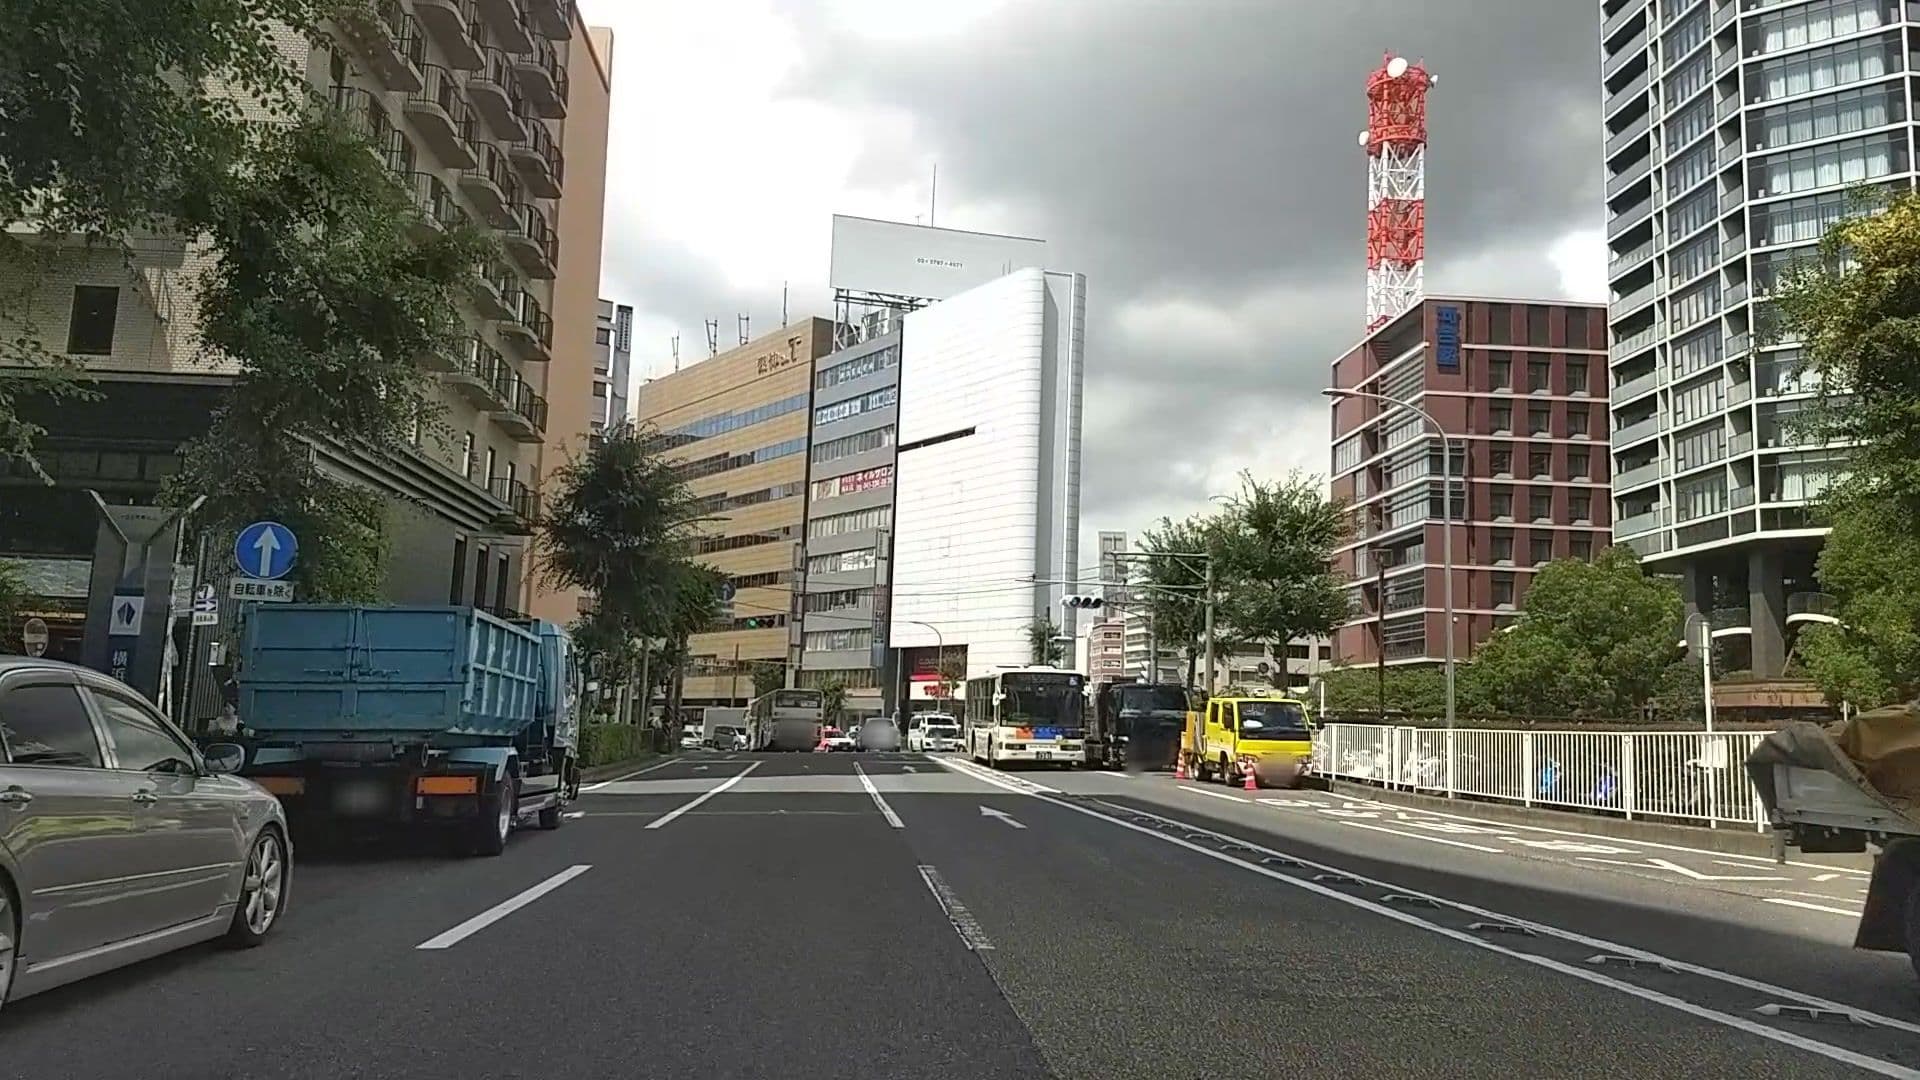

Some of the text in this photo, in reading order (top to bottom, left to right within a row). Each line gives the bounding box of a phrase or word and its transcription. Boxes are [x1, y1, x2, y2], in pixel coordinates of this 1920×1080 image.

[234, 583, 291, 598] 自転車を除く
